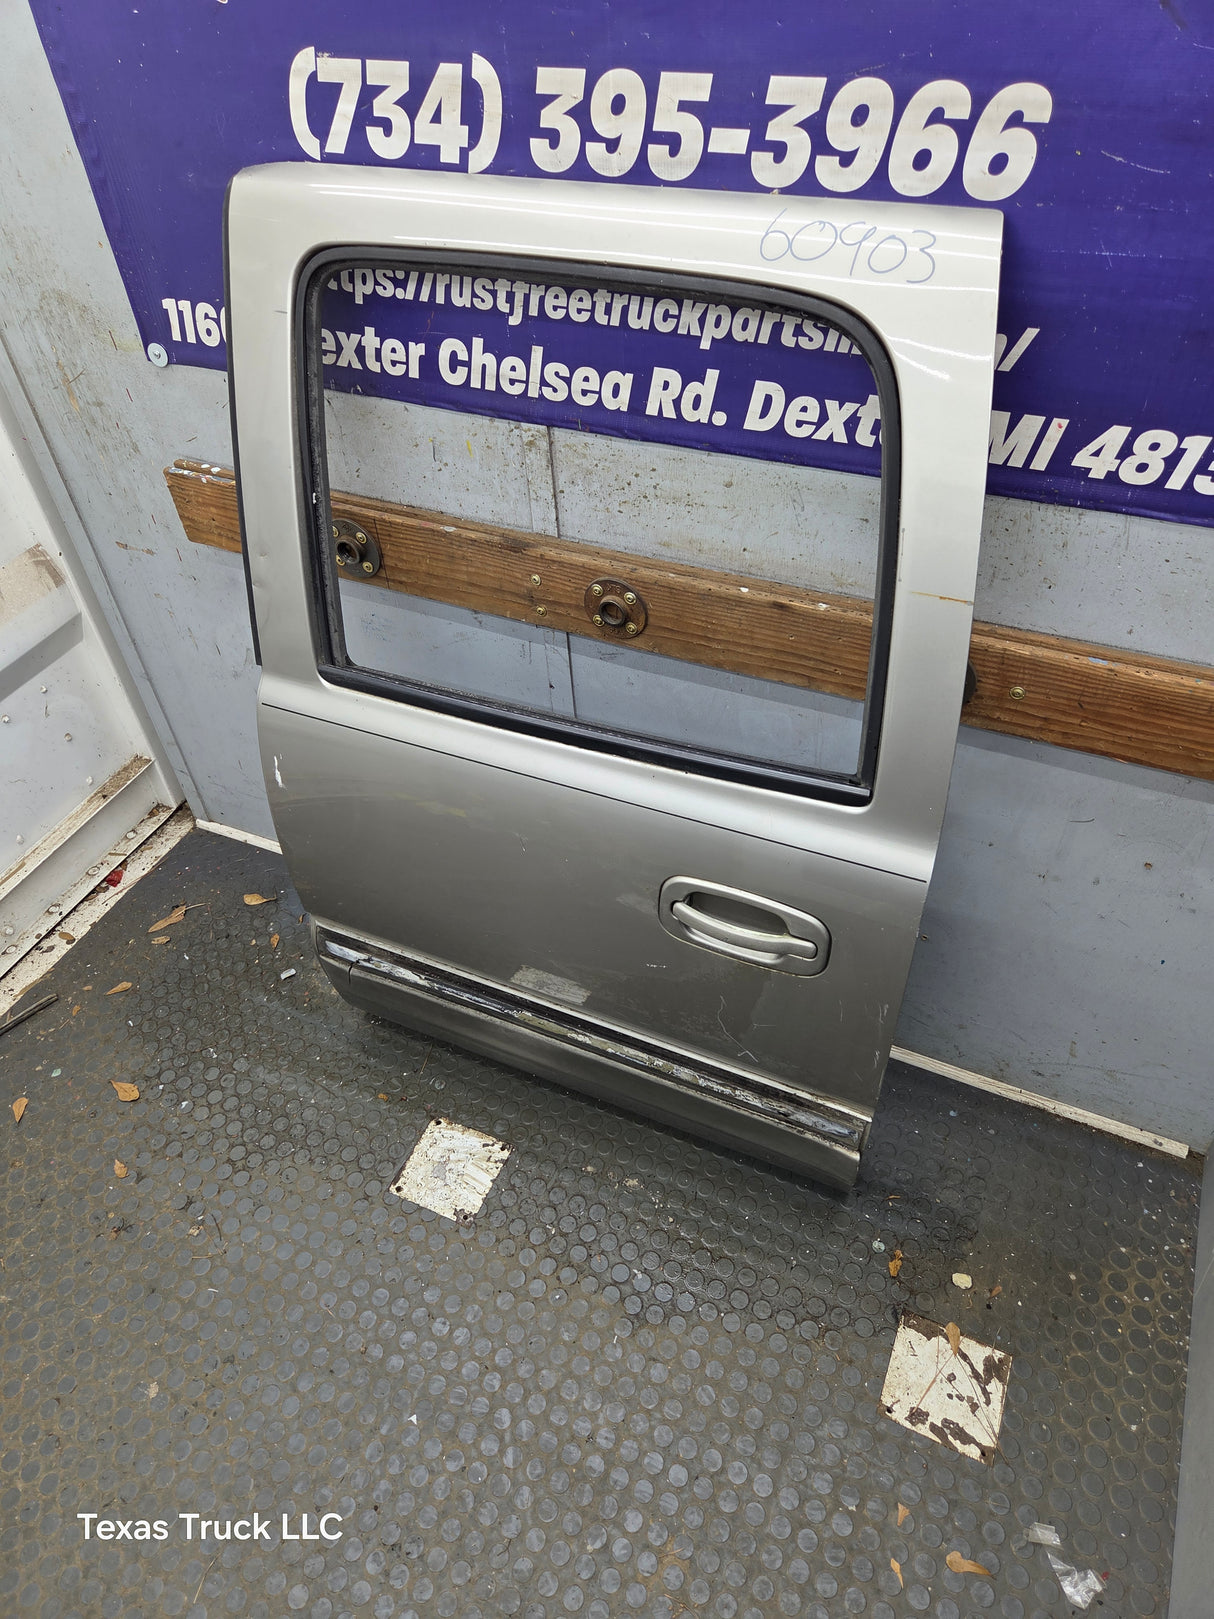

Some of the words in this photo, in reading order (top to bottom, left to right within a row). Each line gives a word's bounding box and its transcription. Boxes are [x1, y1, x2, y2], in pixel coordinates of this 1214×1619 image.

[289, 46, 502, 174] (734)
[529, 67, 1053, 201] 395-3966
[759, 208, 936, 283] 60903
[161, 298, 227, 347] 116
[438, 337, 634, 412] Chelsea
[645, 366, 728, 426] Rd.
[743, 380, 883, 447] Dext
[988, 409, 1070, 471] MI
